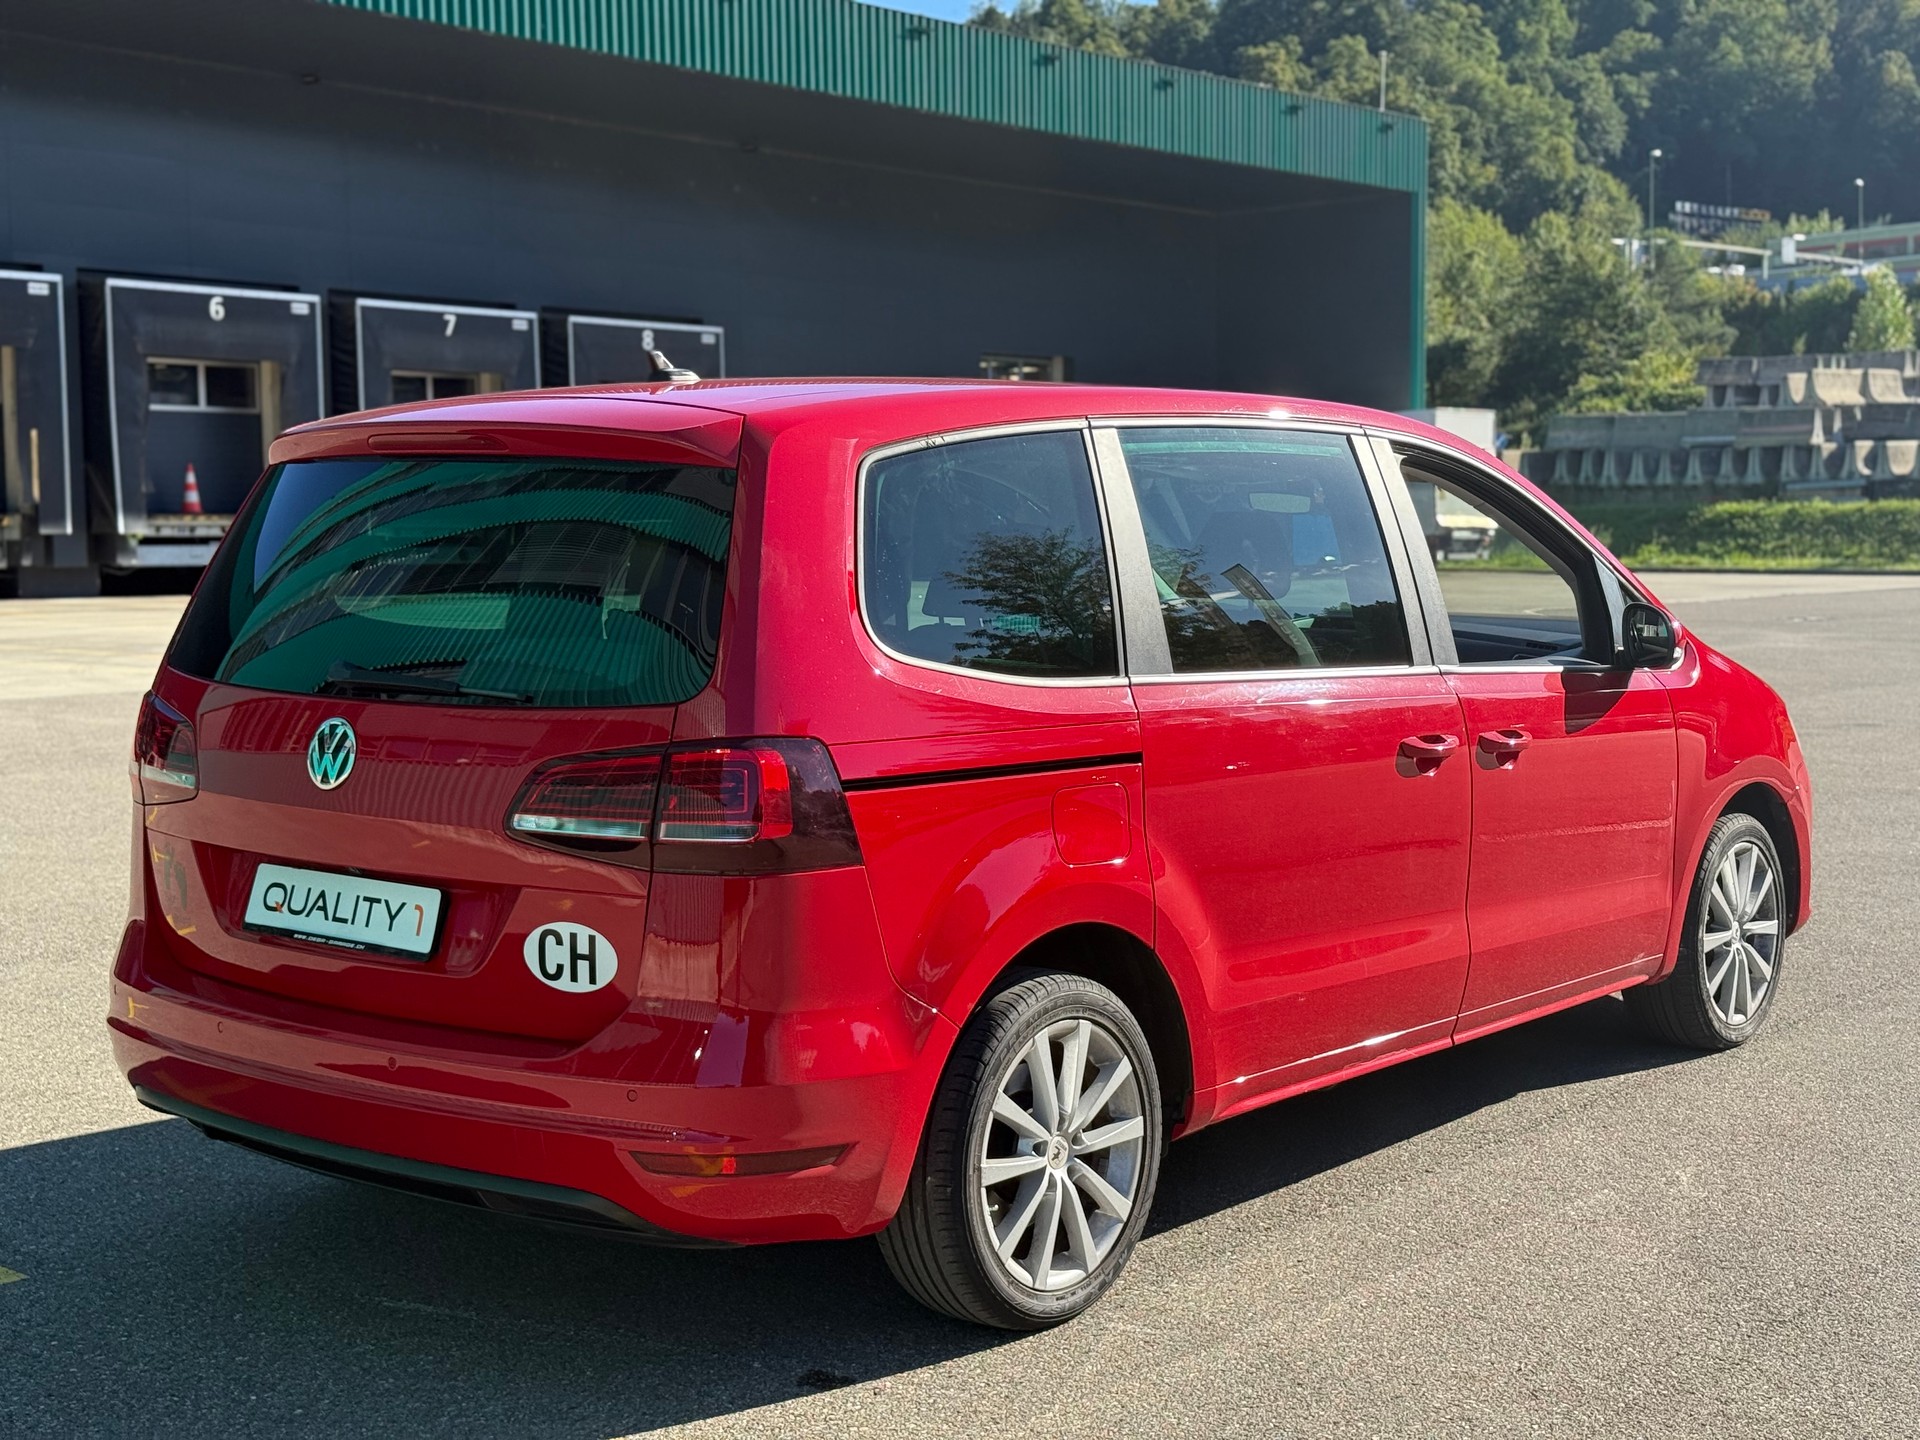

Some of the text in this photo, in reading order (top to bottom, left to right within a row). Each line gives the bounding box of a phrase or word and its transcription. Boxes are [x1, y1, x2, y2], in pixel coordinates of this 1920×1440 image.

[208, 295, 226, 322] 6
[442, 313, 457, 337] 7
[641, 329, 655, 351] 8
[262, 881, 425, 937] QUALITY 1
[537, 928, 598, 986] CH
